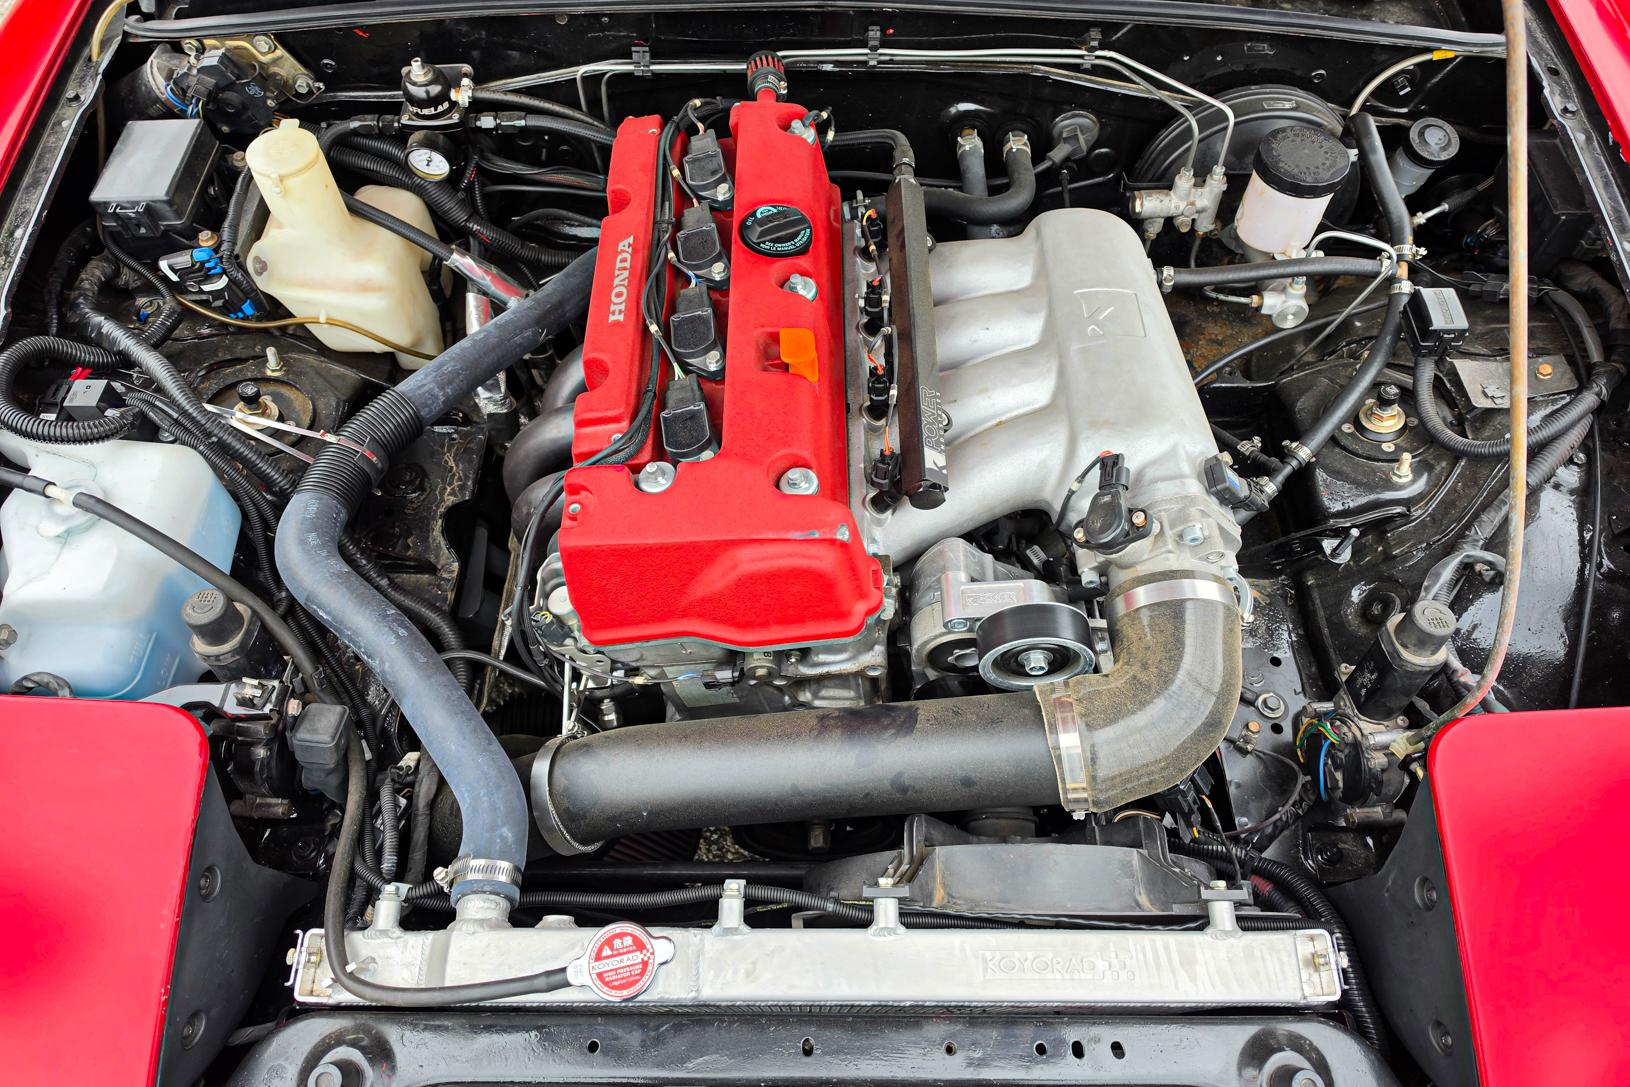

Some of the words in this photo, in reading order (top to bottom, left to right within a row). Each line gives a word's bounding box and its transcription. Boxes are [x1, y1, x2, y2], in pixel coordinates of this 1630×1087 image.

[746, 217, 755, 226] OIL
[608, 234, 635, 323] HONDA
[920, 386, 941, 452] POWER
[612, 935, 634, 950] 危険
[591, 954, 639, 971] KOYORAD
[984, 955, 1096, 974] KOYORAD
